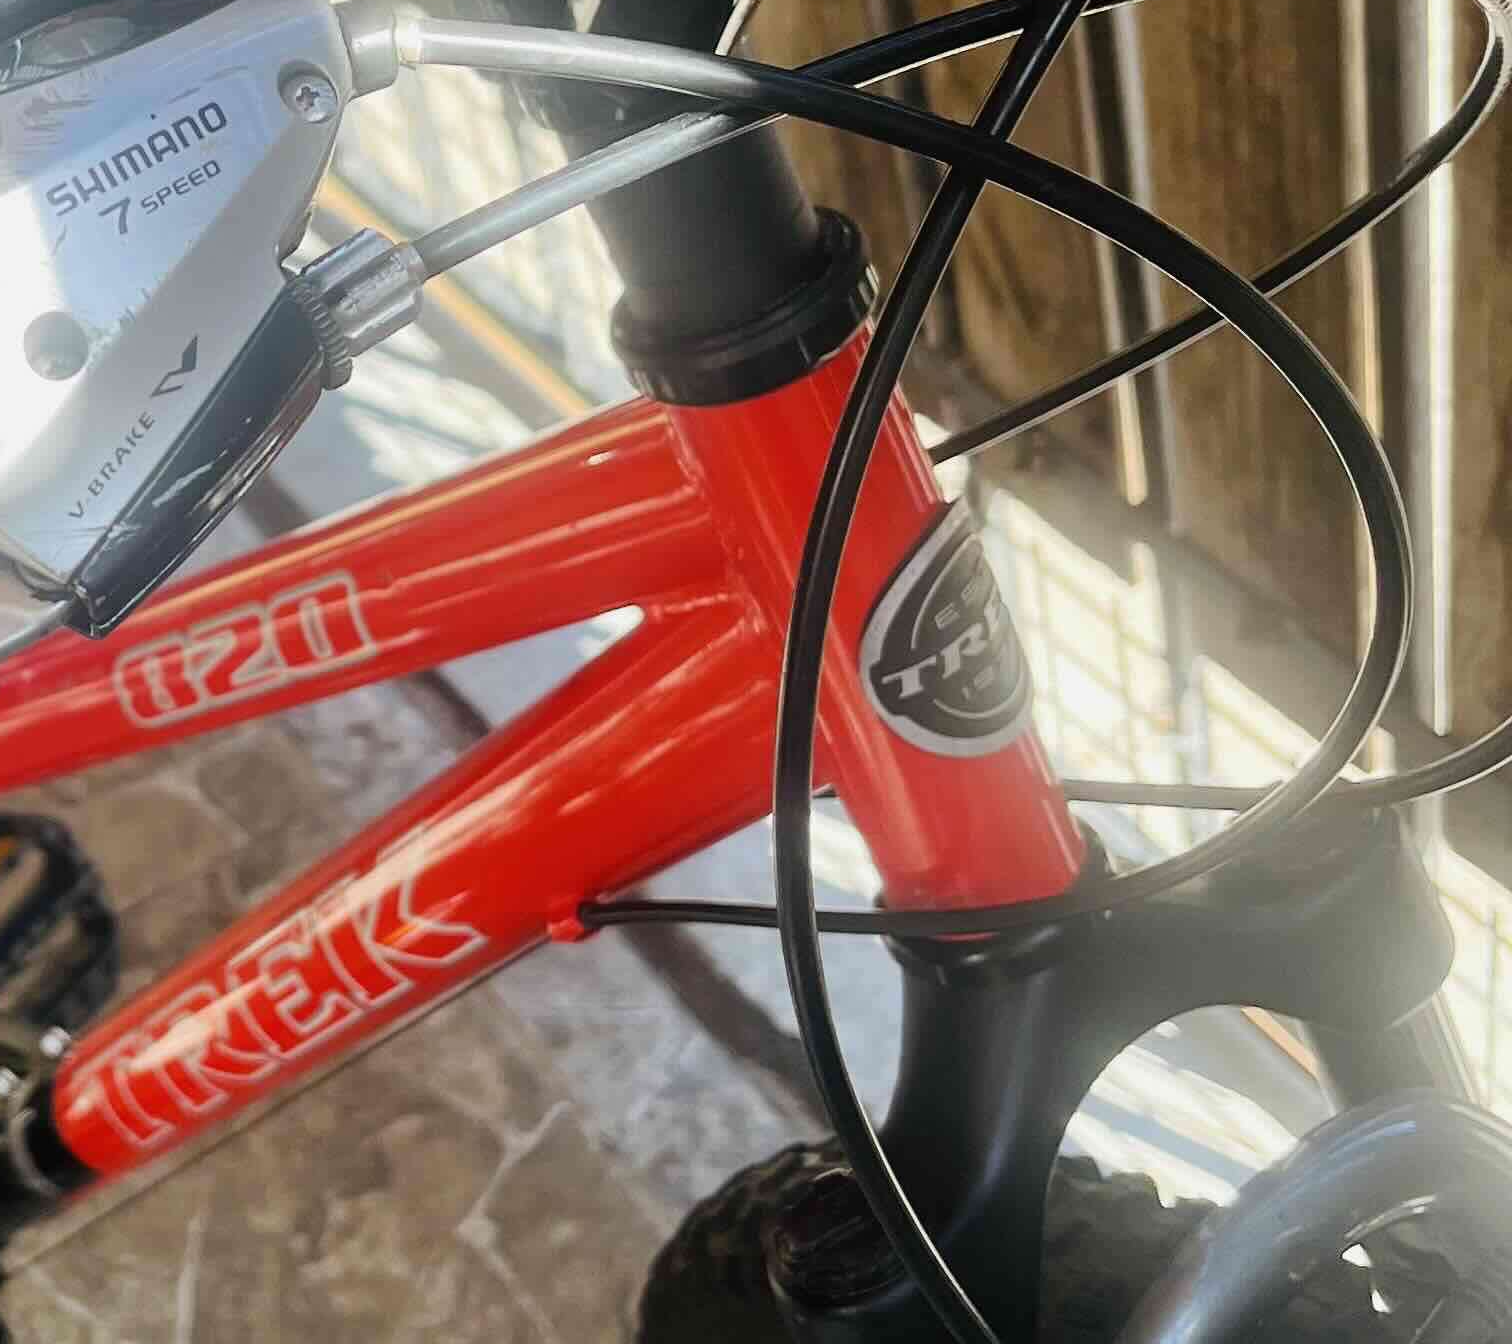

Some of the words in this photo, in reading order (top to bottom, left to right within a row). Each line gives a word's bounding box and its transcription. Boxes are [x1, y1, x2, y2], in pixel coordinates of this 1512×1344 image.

[46, 101, 228, 216] SHIMANO
[98, 198, 133, 236] 7
[140, 159, 222, 216] SPEED
[68, 825, 487, 1147] TREK
